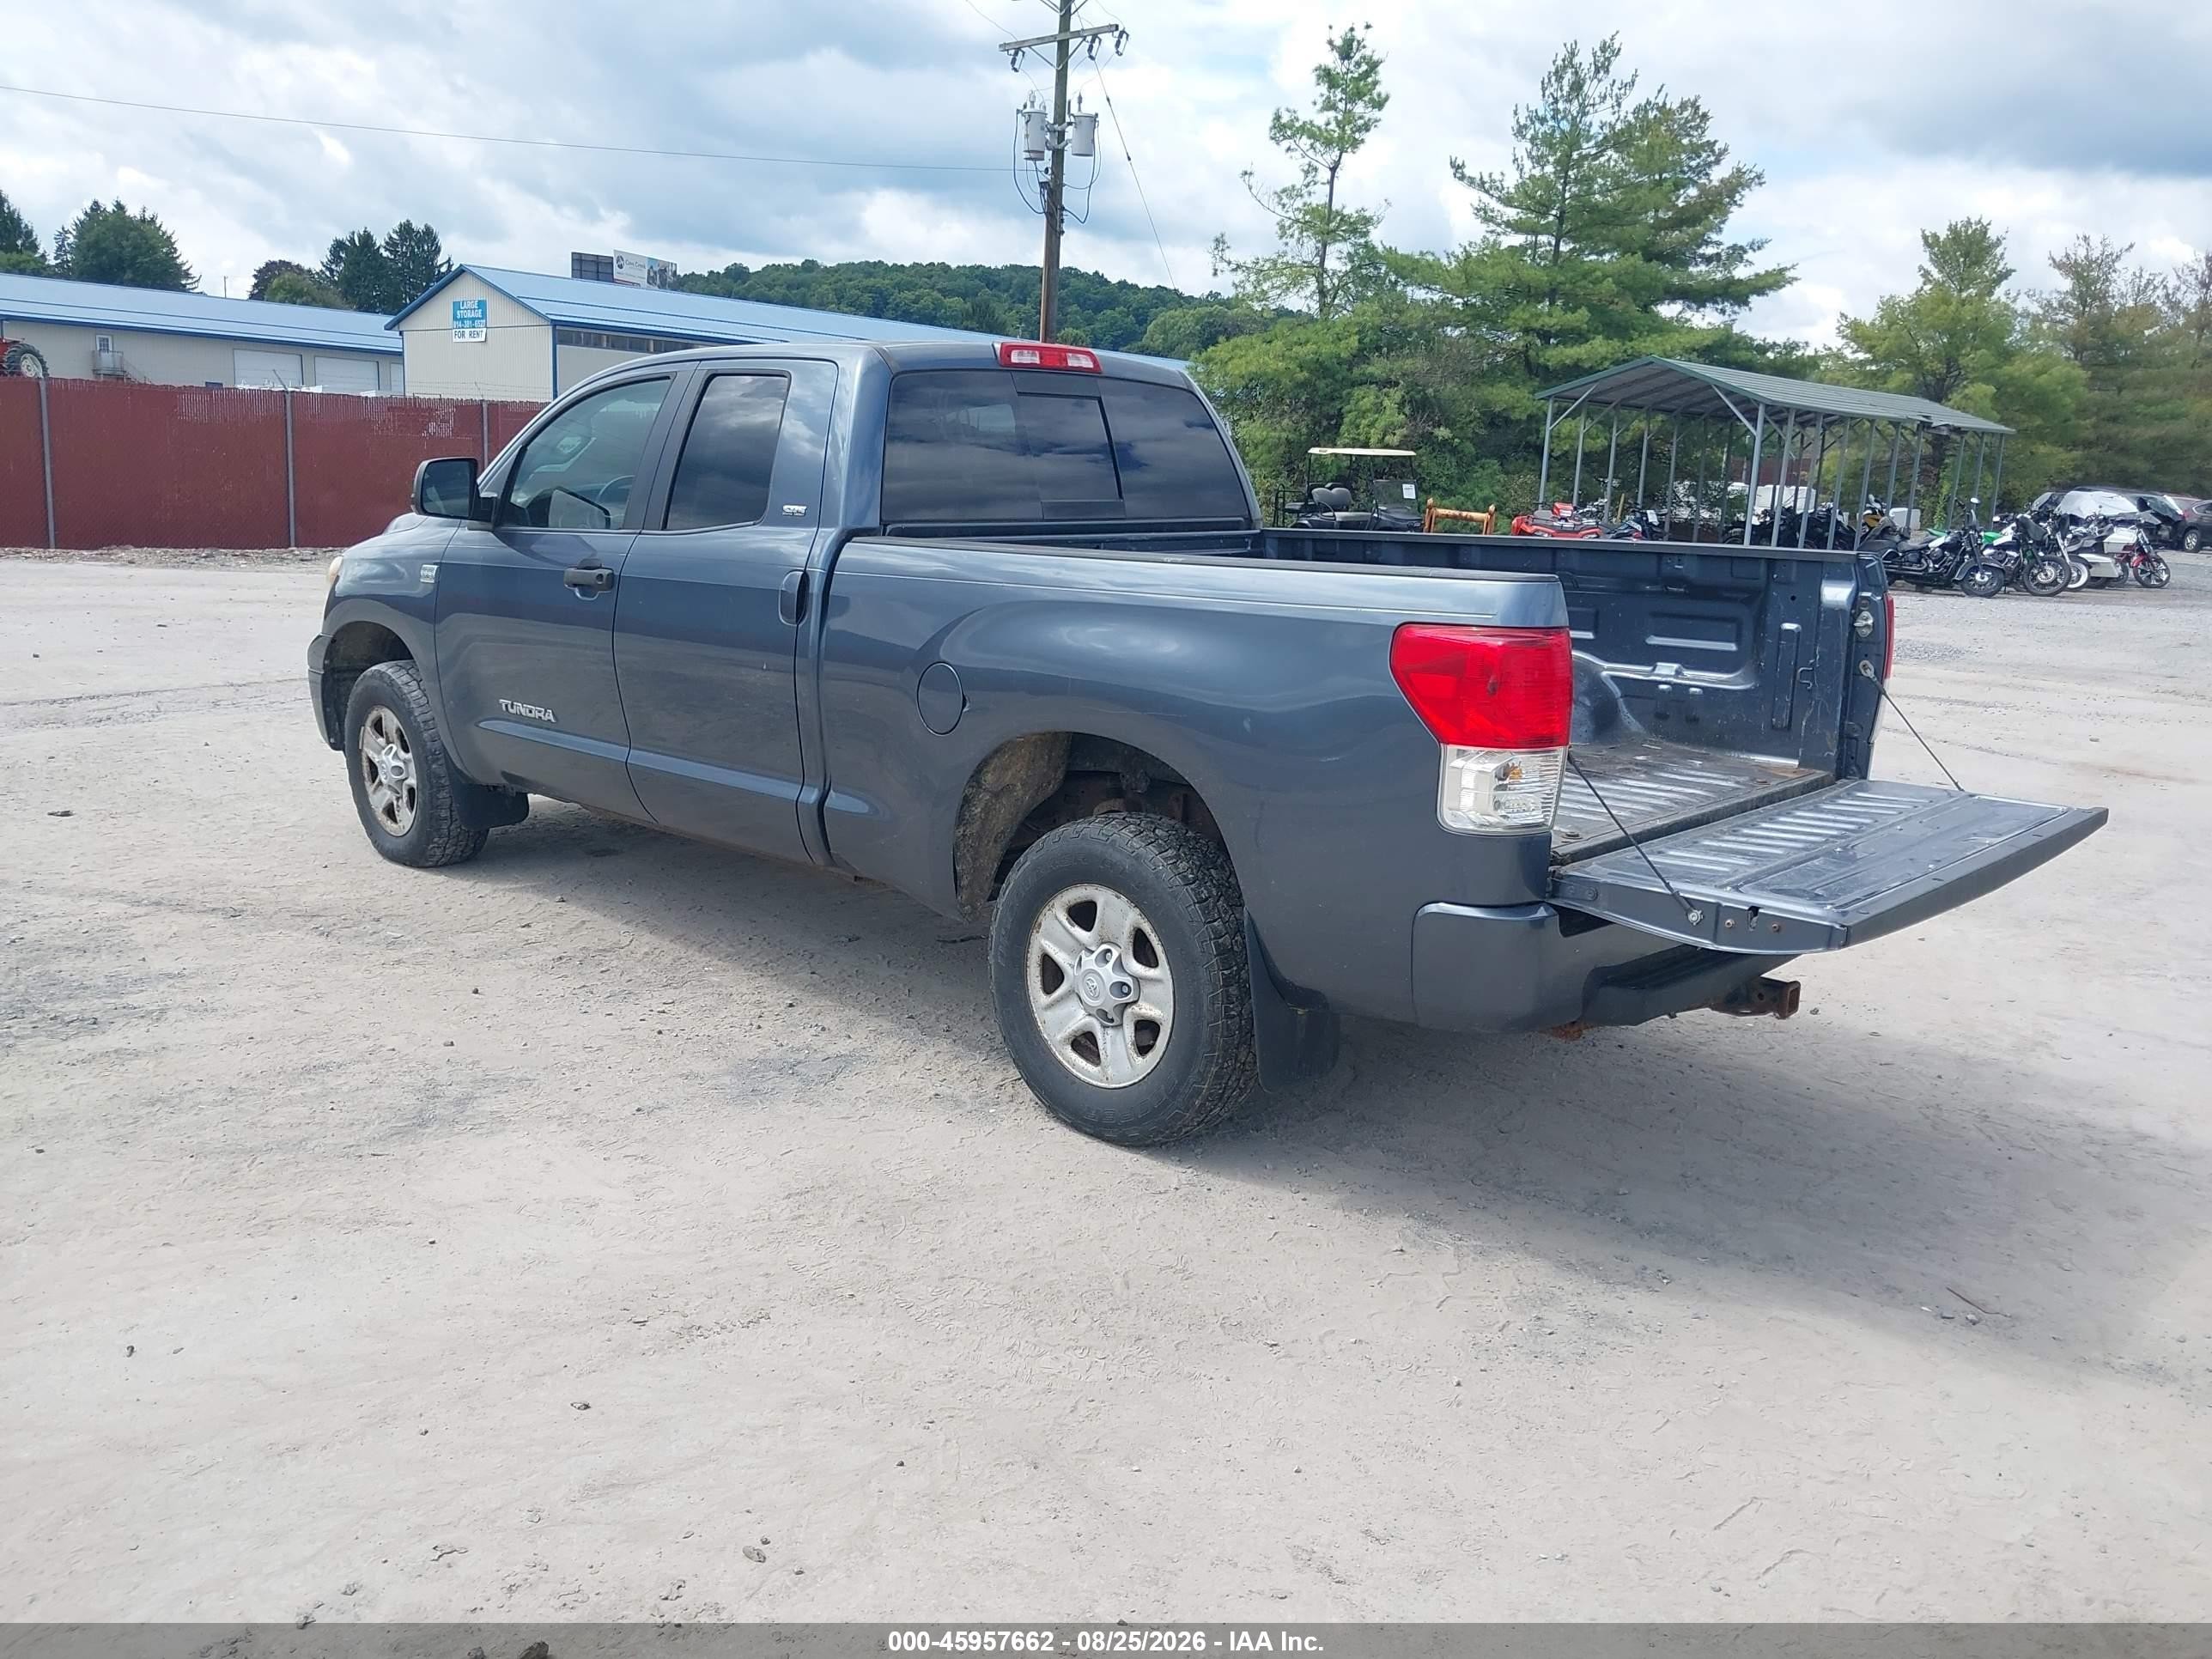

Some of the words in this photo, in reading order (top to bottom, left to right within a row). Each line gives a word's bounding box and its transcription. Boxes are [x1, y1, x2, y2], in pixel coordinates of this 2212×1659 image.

[459, 301, 478, 309] LARGE
[456, 309, 483, 319] STORAGE
[454, 330, 465, 339] FOR
[469, 330, 483, 338] RENT
[499, 699, 556, 722] TUNDRA
